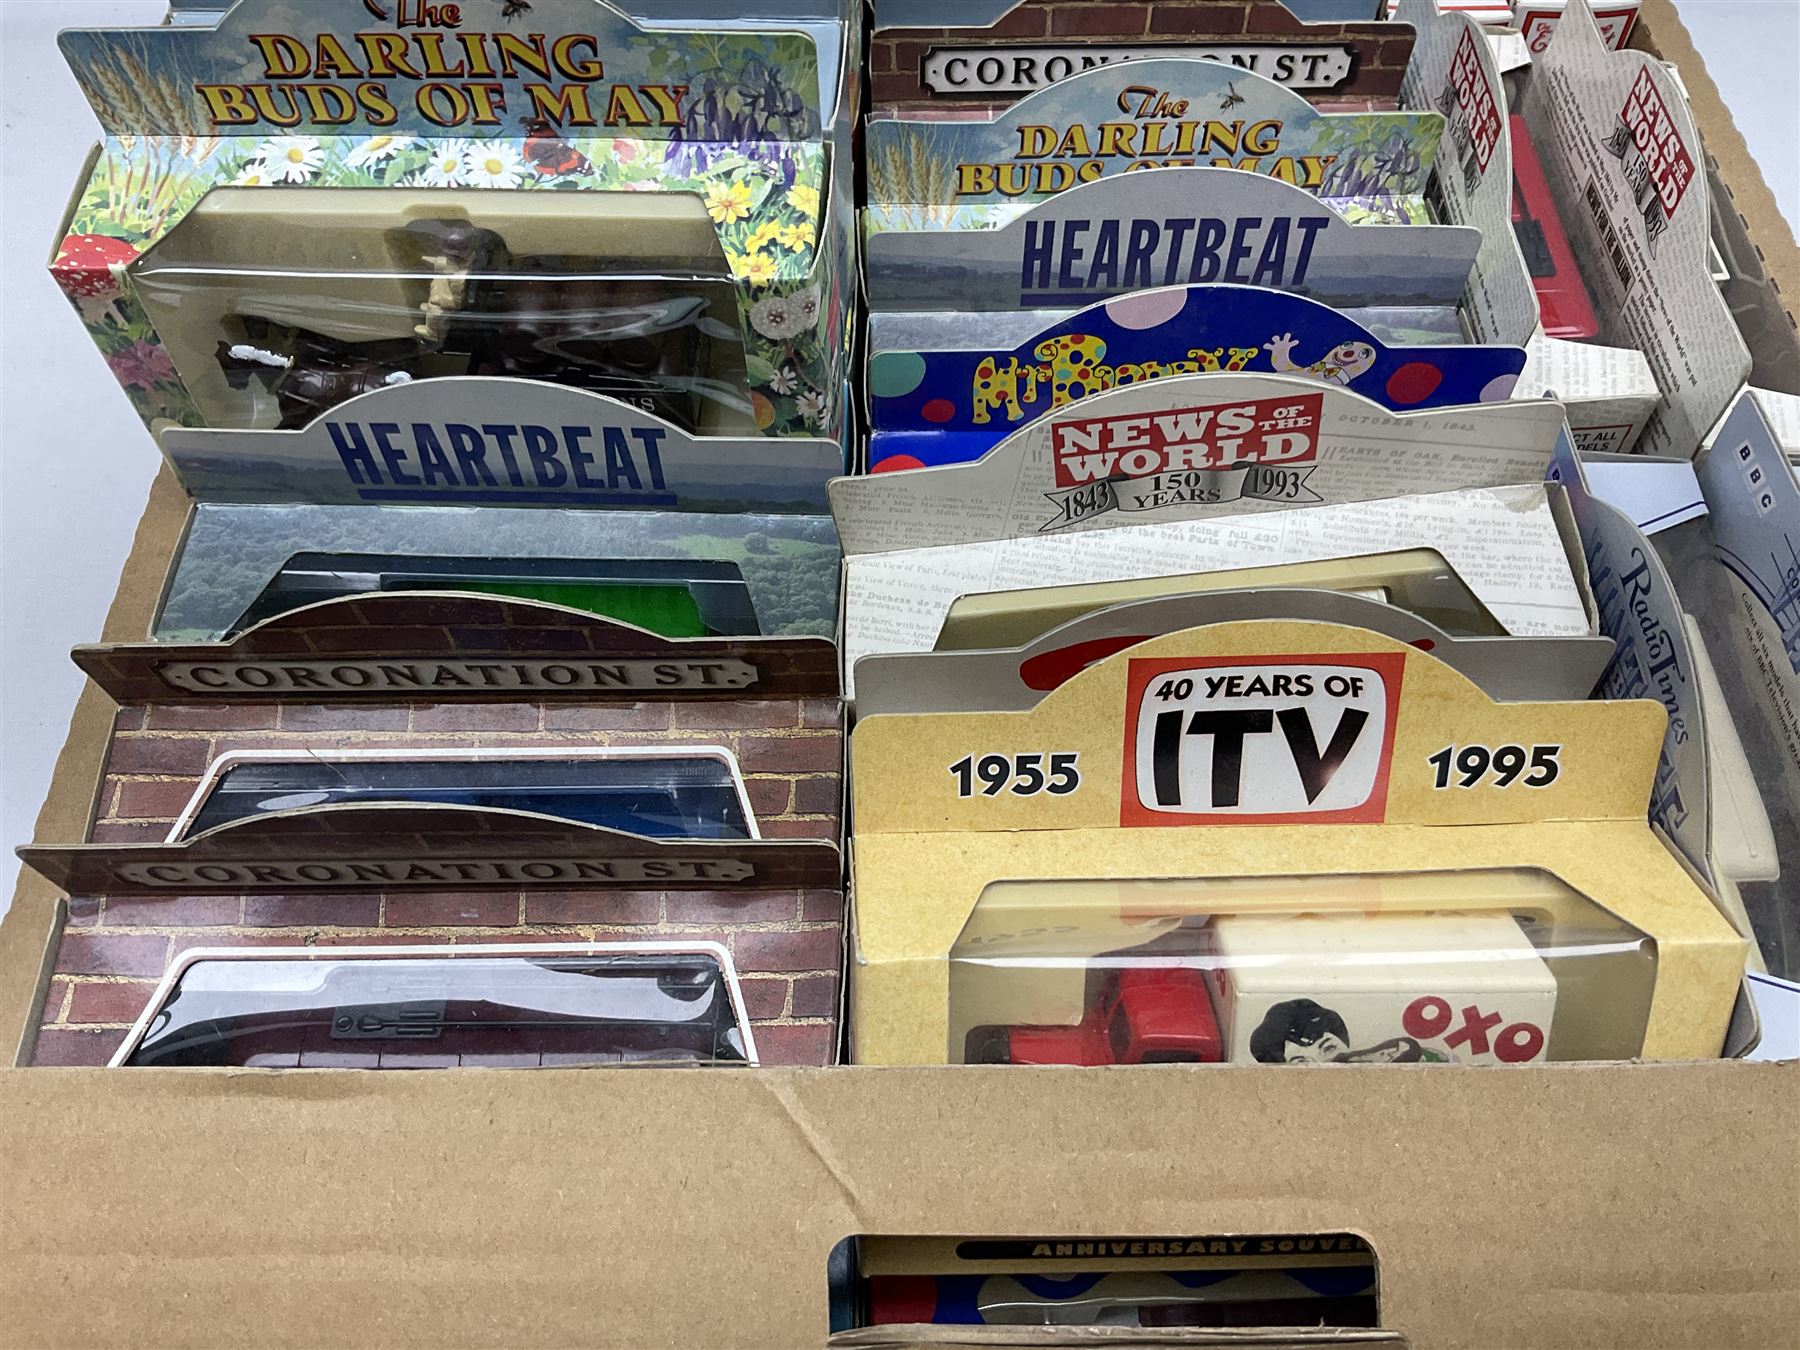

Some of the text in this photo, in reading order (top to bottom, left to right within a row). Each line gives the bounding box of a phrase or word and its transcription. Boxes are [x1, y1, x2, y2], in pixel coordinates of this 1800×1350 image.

[361, 0, 463, 29] The
[250, 34, 604, 80] DARLING
[944, 53, 1333, 87] CORON ST.
[1461, 37, 1491, 118] NEWS
[195, 82, 689, 128] BUDS OF MAY
[1117, 84, 1190, 119] The
[1451, 58, 1488, 165] WORLD
[1634, 75, 1681, 162] NEWS
[1016, 119, 1286, 159] DARLING
[1626, 95, 1678, 211] WORLD
[957, 161, 1107, 196] BUDS
[1633, 156, 1647, 181] 150
[1019, 216, 1331, 289] HEARTBEAT
[1057, 405, 1313, 455] NEWS OF THE
[1593, 431, 1617, 441] ALL
[324, 422, 667, 491] HEARTBEAT
[1060, 433, 1312, 482] WORLD
[1062, 481, 1110, 522] 1843
[1132, 486, 1222, 511] YEARS
[1150, 471, 1202, 493] 150
[1250, 467, 1302, 498] 1993
[1012, 513, 1030, 521] Old
[1188, 525, 1220, 539] doing
[1228, 529, 1249, 541] full
[1138, 528, 1156, 538] the
[1160, 530, 1186, 542] best
[1188, 534, 1220, 546] Parts
[1226, 540, 1240, 549] of
[1241, 540, 1275, 552] Town
[1503, 553, 1533, 563] where
[867, 591, 931, 607] Duchess de
[1620, 547, 1661, 659] Radio
[1648, 628, 1689, 746] Times
[1742, 592, 1759, 629] Collect
[1755, 628, 1765, 643] all
[1761, 642, 1770, 657] six
[1767, 658, 1785, 694] models
[1782, 695, 1794, 718] that
[188, 660, 739, 693] CORONATION ST.
[1154, 673, 1367, 702] 40 YEARS OF
[1765, 680, 1792, 742] Television's
[949, 751, 1081, 798] 1955
[1150, 707, 1370, 809] ITV
[1427, 744, 1562, 791] 1995
[143, 857, 735, 887] CORONATION ST.
[1402, 995, 1545, 1064] OXO
[1030, 1239, 1248, 1258] ANNIVERSARY
